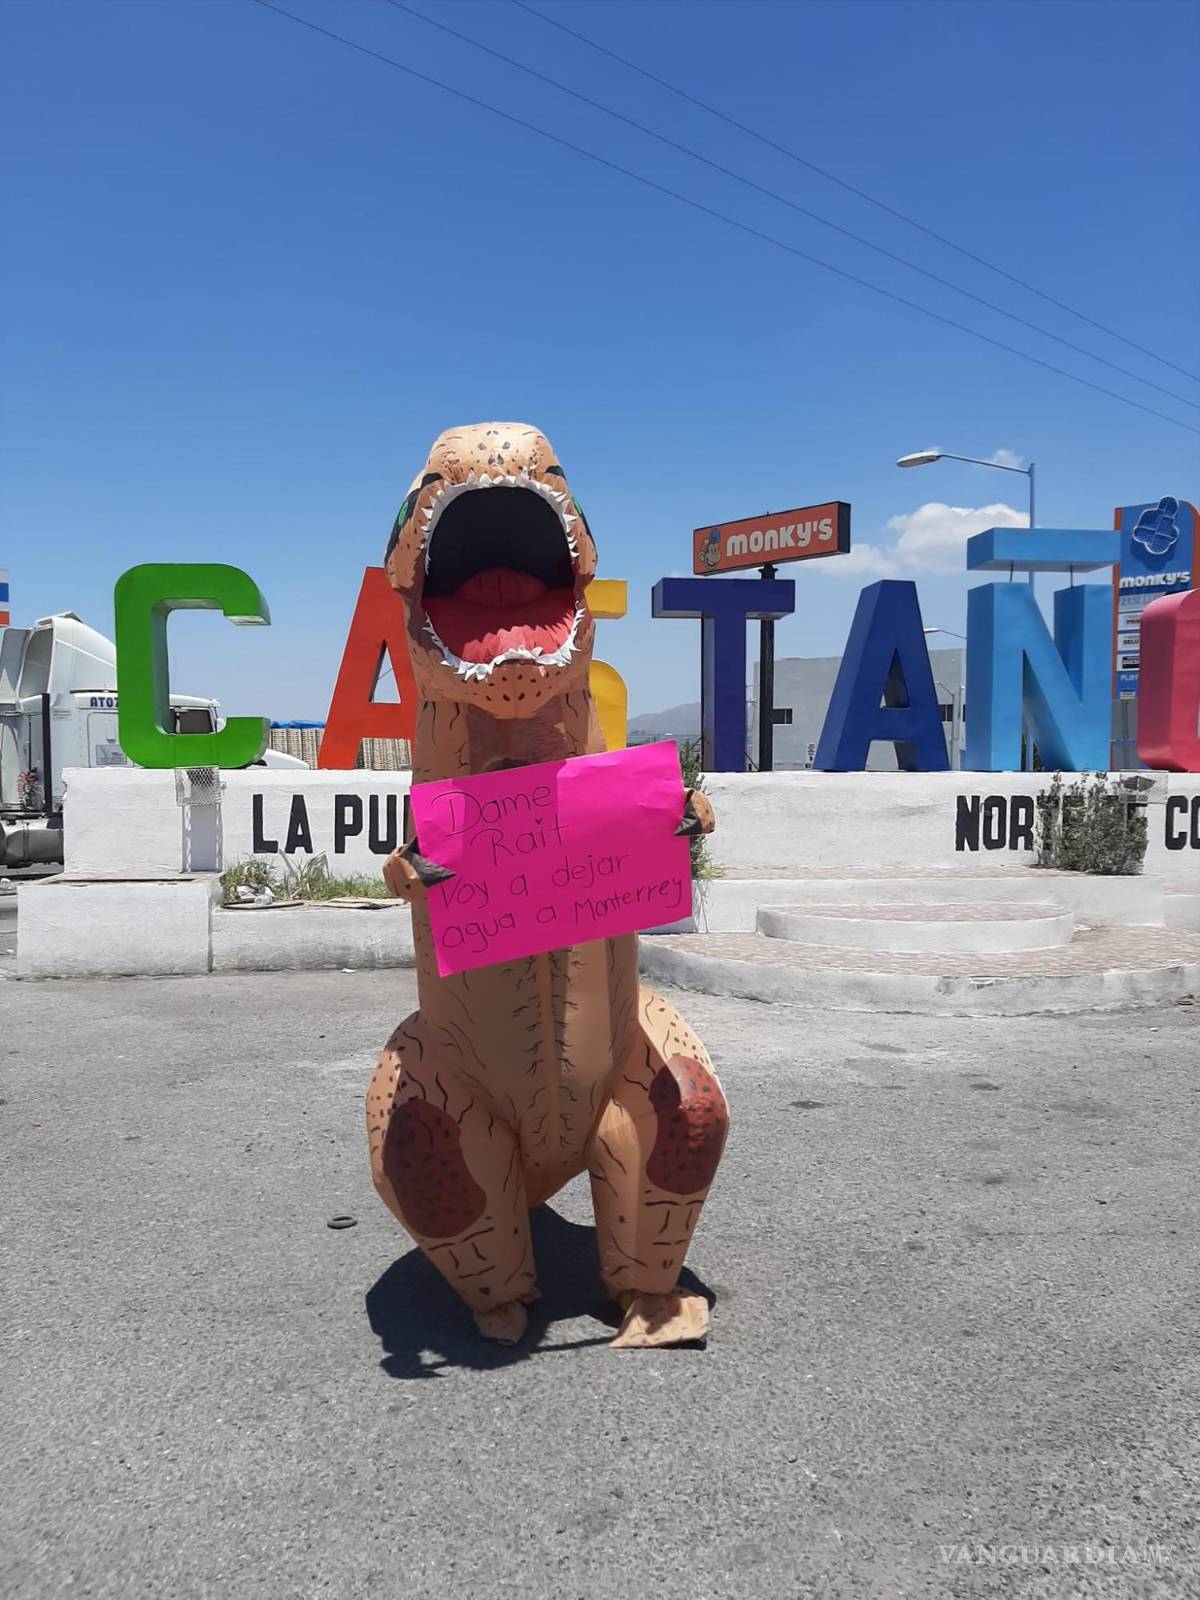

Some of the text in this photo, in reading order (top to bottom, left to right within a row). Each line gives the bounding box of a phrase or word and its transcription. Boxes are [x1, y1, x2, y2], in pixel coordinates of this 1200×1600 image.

[253, 794, 313, 854] LA
[334, 794, 411, 855] PU
[955, 795, 1084, 852] NOR
[431, 785, 553, 837] Dame
[470, 814, 569, 866] Rait
[439, 853, 631, 909] Voy a dejar
[442, 876, 683, 953] agua a Monterrey
